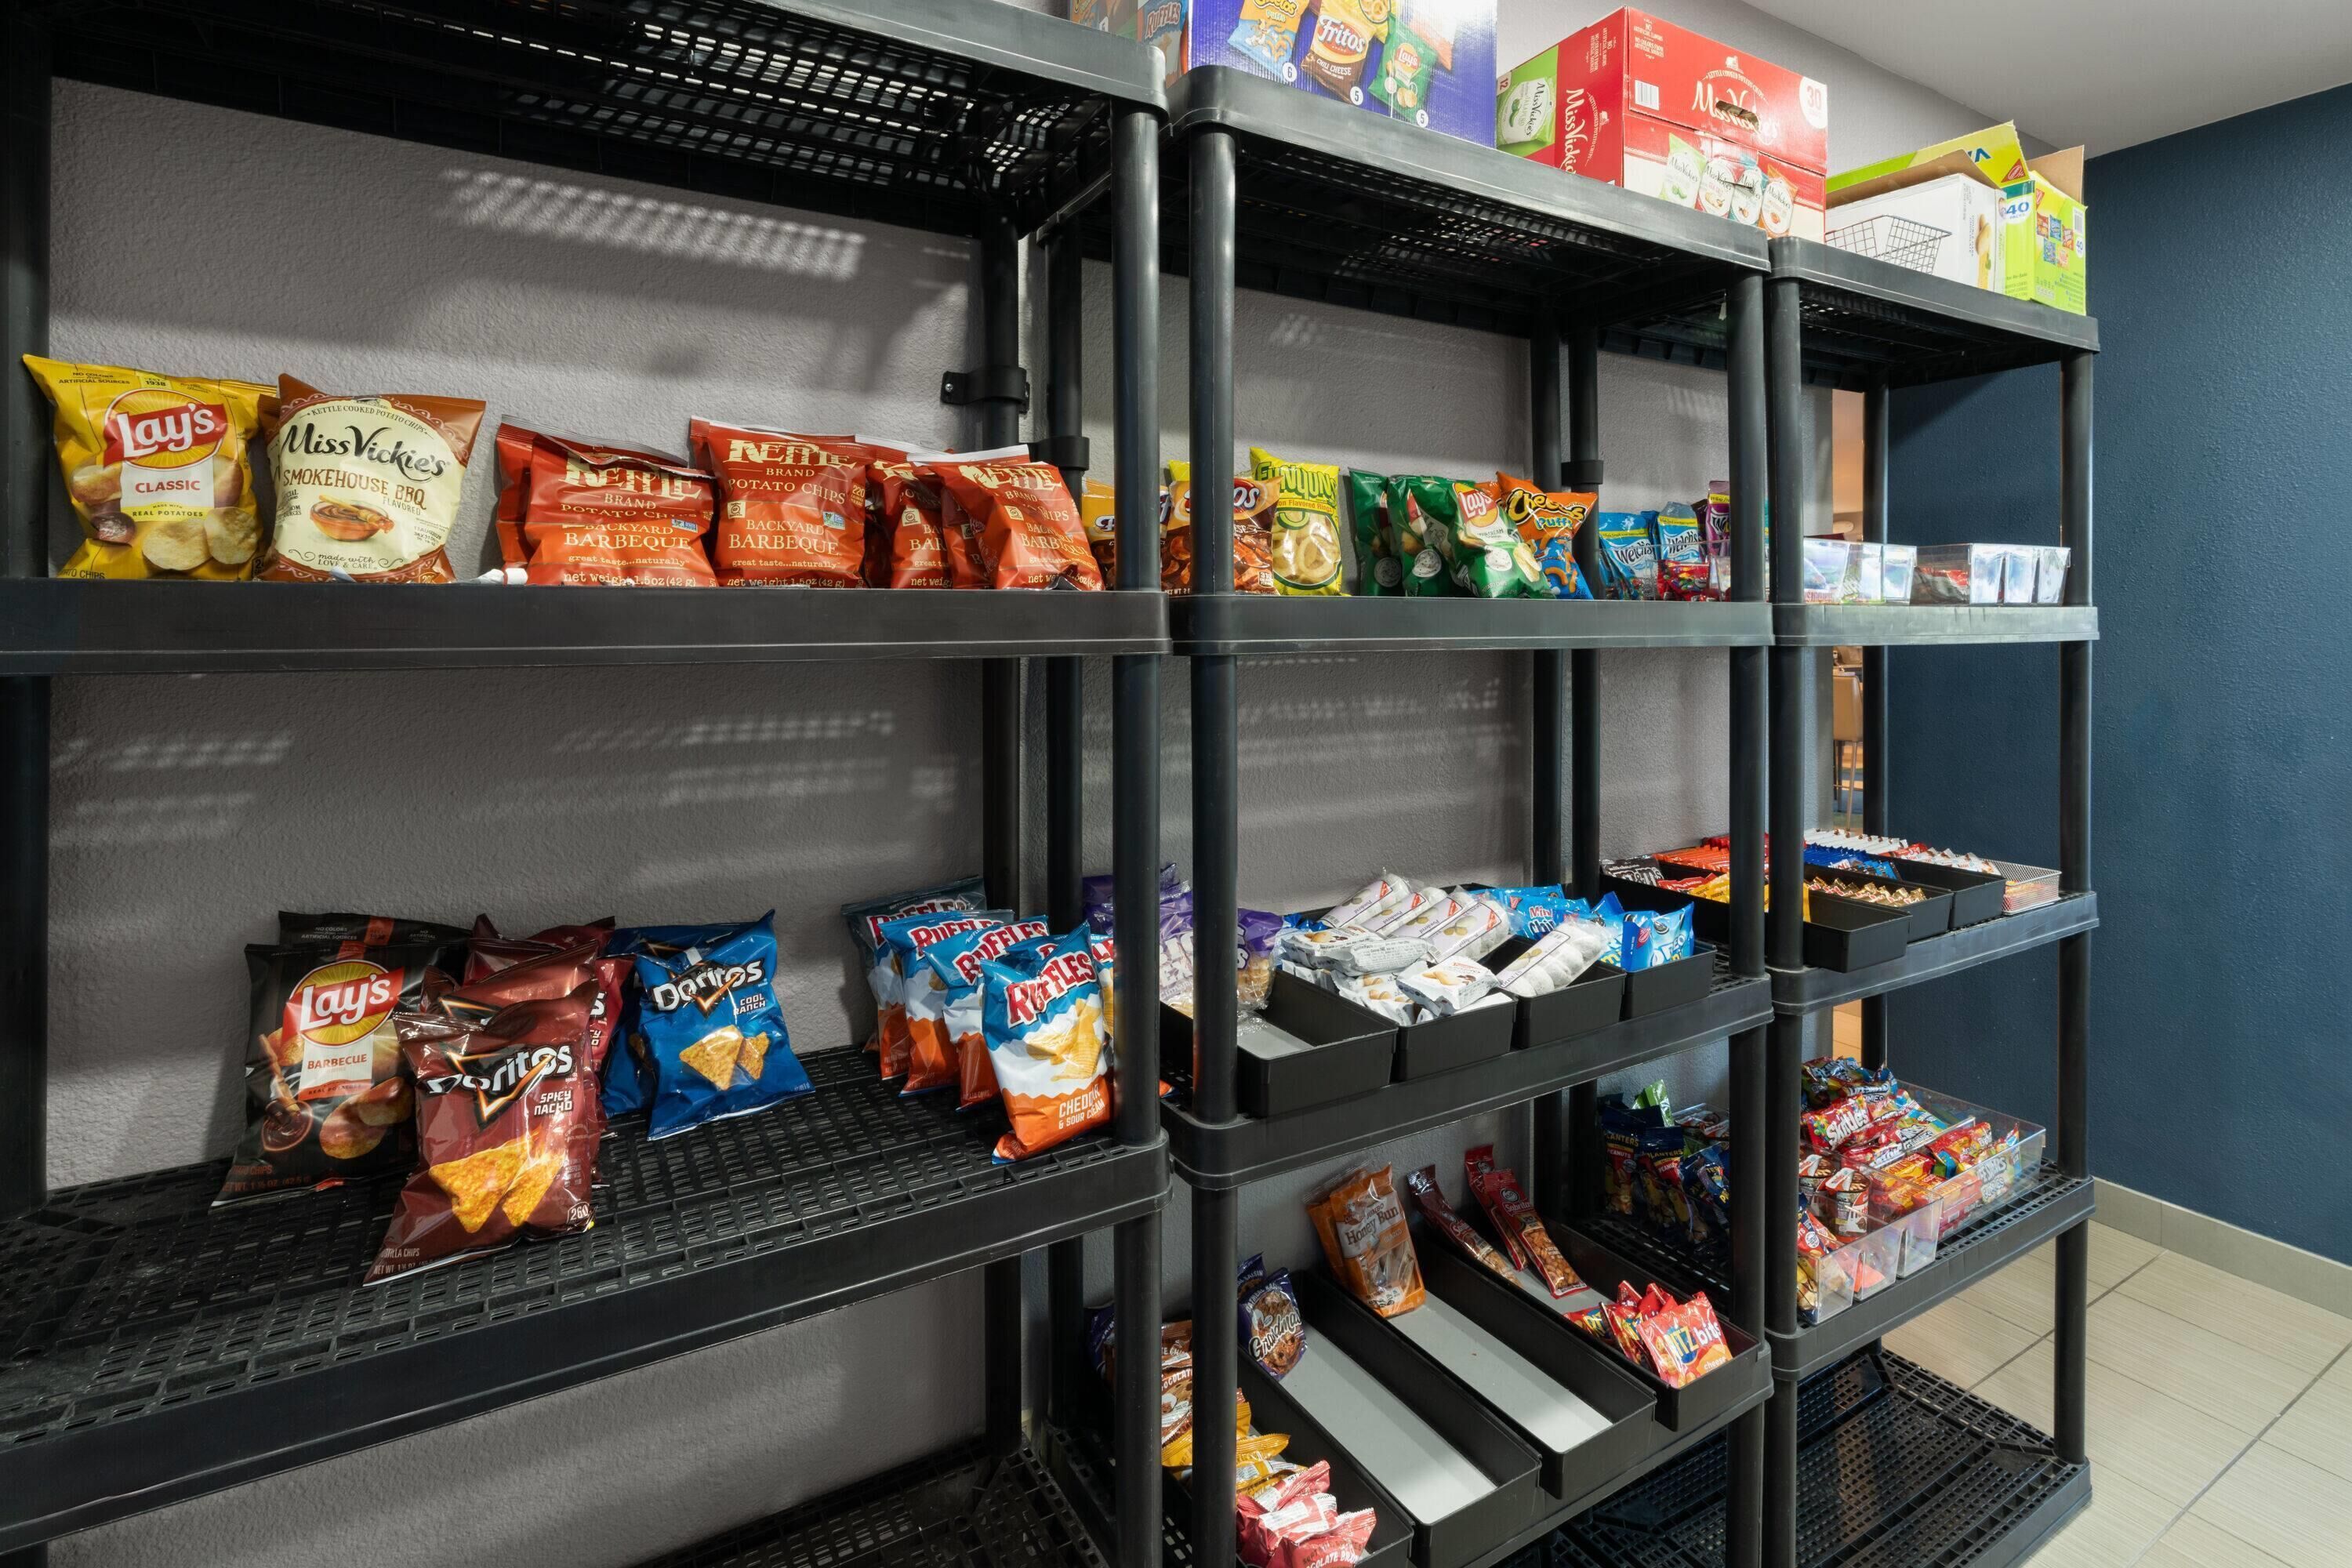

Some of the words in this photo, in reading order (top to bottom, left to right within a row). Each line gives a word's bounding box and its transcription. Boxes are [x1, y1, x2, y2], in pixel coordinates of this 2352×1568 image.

[1147, 4, 1181, 37] RUFFLES
[1318, 15, 1367, 54] Fritos
[1287, 68, 1292, 78] 6
[1316, 58, 1329, 70] CHILI
[1330, 63, 1352, 75] CHEESE
[1500, 78, 1508, 90] 12
[1354, 91, 1359, 101] 5
[1806, 85, 1821, 111] 30
[1565, 89, 1584, 129] Miss
[1420, 114, 1425, 124] 5
[2006, 202, 2029, 215] 40
[311, 405, 342, 416] KETTLE
[343, 405, 375, 415] COOKED
[376, 409, 404, 423] POTATO
[404, 419, 426, 433] CHIPS
[117, 402, 216, 458] Lay's
[281, 423, 350, 455] Miss
[345, 425, 446, 482] Vickie's
[723, 439, 856, 469] KETTLE
[135, 480, 201, 493] CLASSIC
[283, 468, 389, 495] SMOKEHOUSE
[394, 484, 427, 510] BBQ
[728, 479, 796, 492] POTATO
[802, 483, 845, 505] CHIPS
[853, 485, 865, 498] 220
[382, 496, 421, 516] FLAVORED
[604, 493, 656, 510] BRAND
[1288, 499, 1316, 509] Flavored
[1317, 503, 1333, 514] Rings
[561, 503, 637, 518] POTATO
[746, 520, 824, 535] BACKYARD
[564, 532, 693, 551] BARBEQUE
[729, 534, 839, 555] BARBEQUE
[1668, 530, 1699, 554] Welch's
[348, 555, 376, 564] with
[568, 554, 597, 563] great
[79, 570, 106, 579] CHIPS
[564, 573, 586, 583] net
[728, 578, 746, 586] net
[750, 577, 788, 588] weight
[911, 577, 927, 586] net
[1029, 575, 1043, 583] net
[1530, 906, 1553, 918] Mini
[653, 960, 764, 1011] Doritos
[1006, 952, 1096, 1026] RUFFLES
[299, 975, 391, 1033] Lay's
[740, 993, 764, 1004] COOL
[733, 1000, 766, 1015] RANCH
[307, 1053, 368, 1070] BARBECUE
[426, 1045, 575, 1094] Doritos
[540, 1091, 572, 1103] SPICY
[1058, 1085, 1100, 1117] CHEDDAR
[534, 1099, 573, 1116] NACHO
[1058, 1120, 1064, 1129] &
[1066, 1113, 1084, 1127] SOUR
[1087, 1098, 1105, 1119] CREAM
[1826, 1109, 1870, 1146] Skittles
[251, 1164, 272, 1174] CHIPS
[570, 1206, 590, 1221] 260
[1345, 1218, 1377, 1246] Honey
[1377, 1206, 1399, 1225] Bun
[403, 1248, 419, 1258] CHIPS
[1693, 1322, 1722, 1345] bits
[1704, 1356, 1726, 1370] cheese
